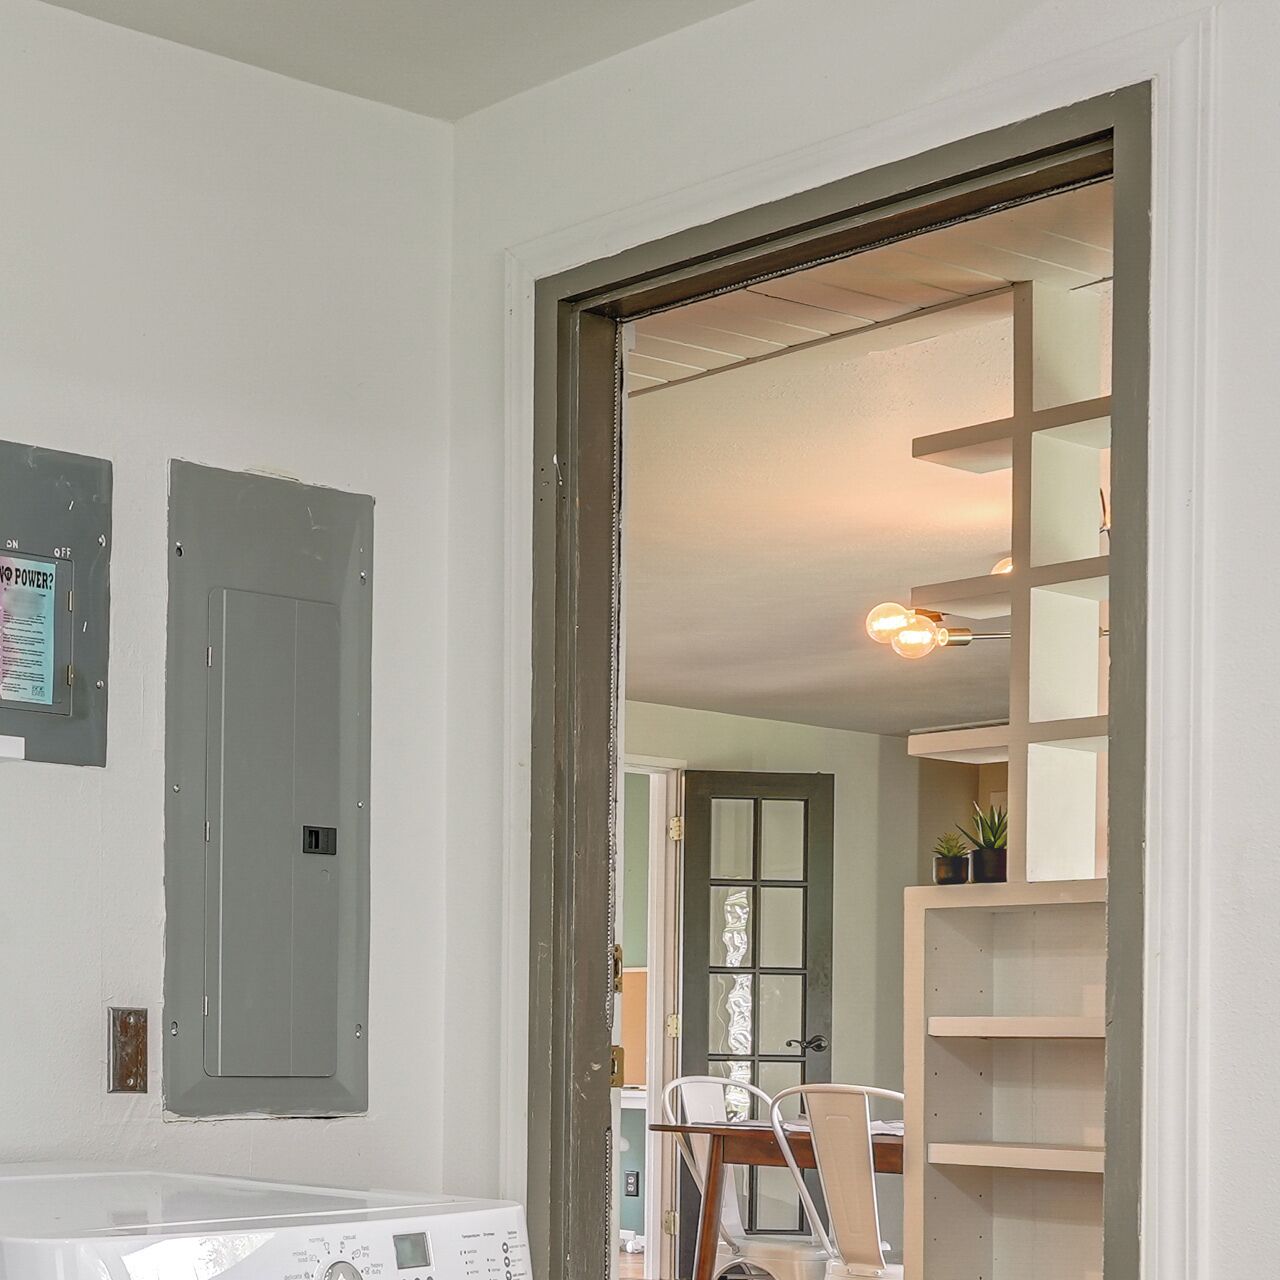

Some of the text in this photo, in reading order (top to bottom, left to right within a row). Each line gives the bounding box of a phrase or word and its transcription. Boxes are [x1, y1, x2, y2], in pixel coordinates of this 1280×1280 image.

[6, 540, 19, 549] ON
[53, 547, 71, 557] OFF
[15, 568, 54, 590] POWER?
